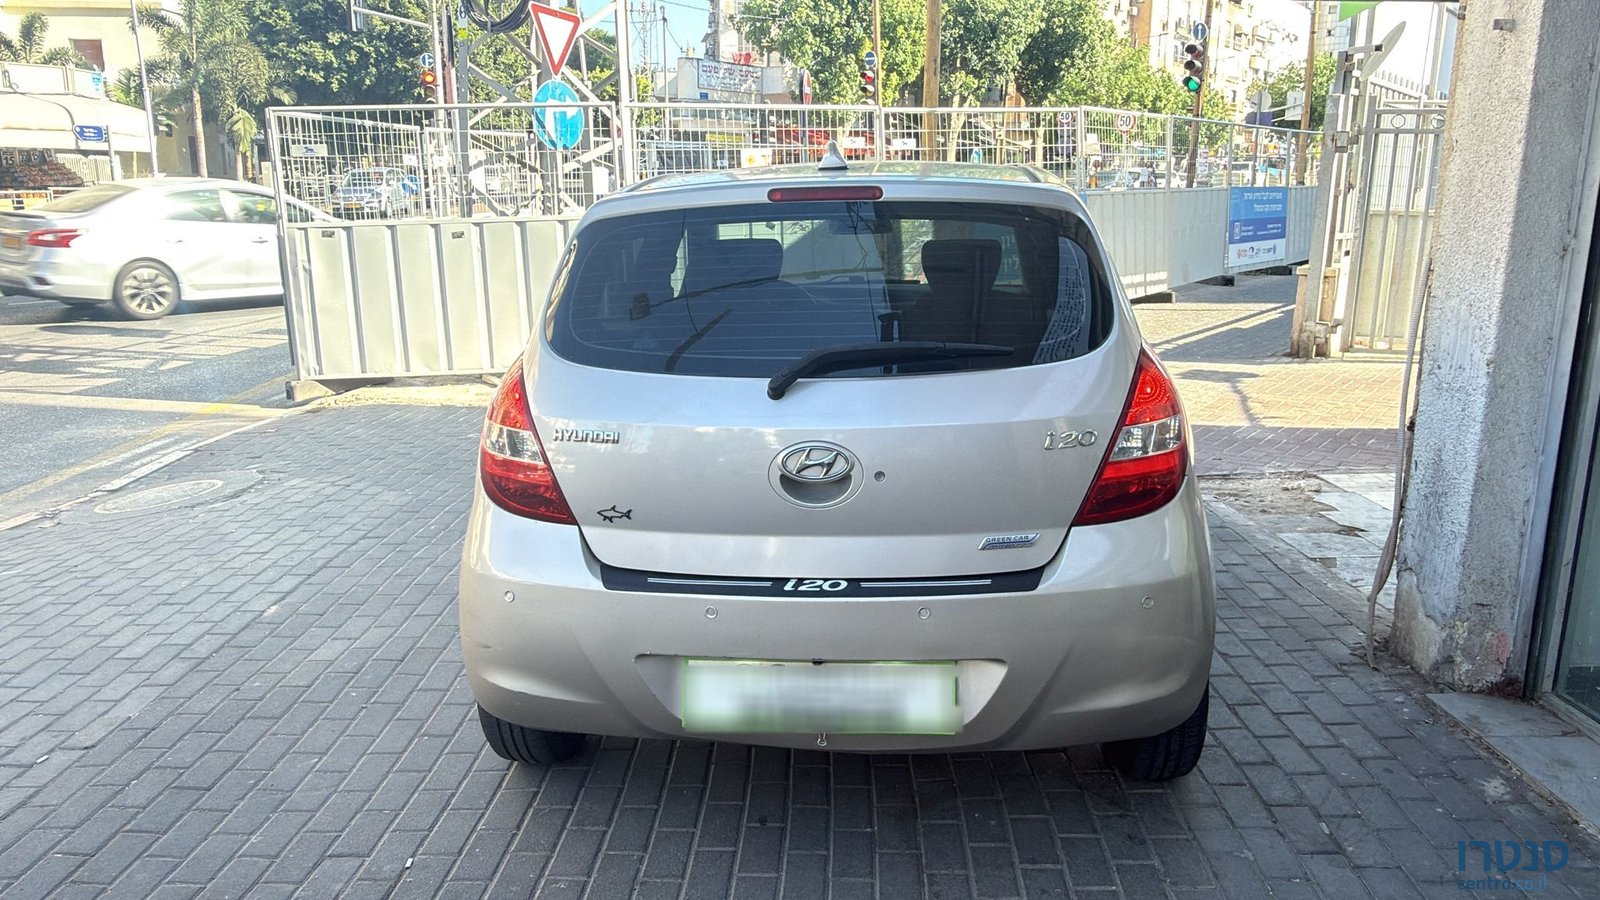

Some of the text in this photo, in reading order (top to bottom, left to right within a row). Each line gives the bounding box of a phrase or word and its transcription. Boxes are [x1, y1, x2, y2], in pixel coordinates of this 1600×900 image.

[702, 64, 719, 74] פעם
[1060, 112, 1070, 121] 50
[1120, 115, 1131, 127] 50
[3, 156, 15, 166] 15
[552, 428, 620, 444] HYUNDAI
[1044, 428, 1098, 450] i20
[783, 578, 849, 591] i20
